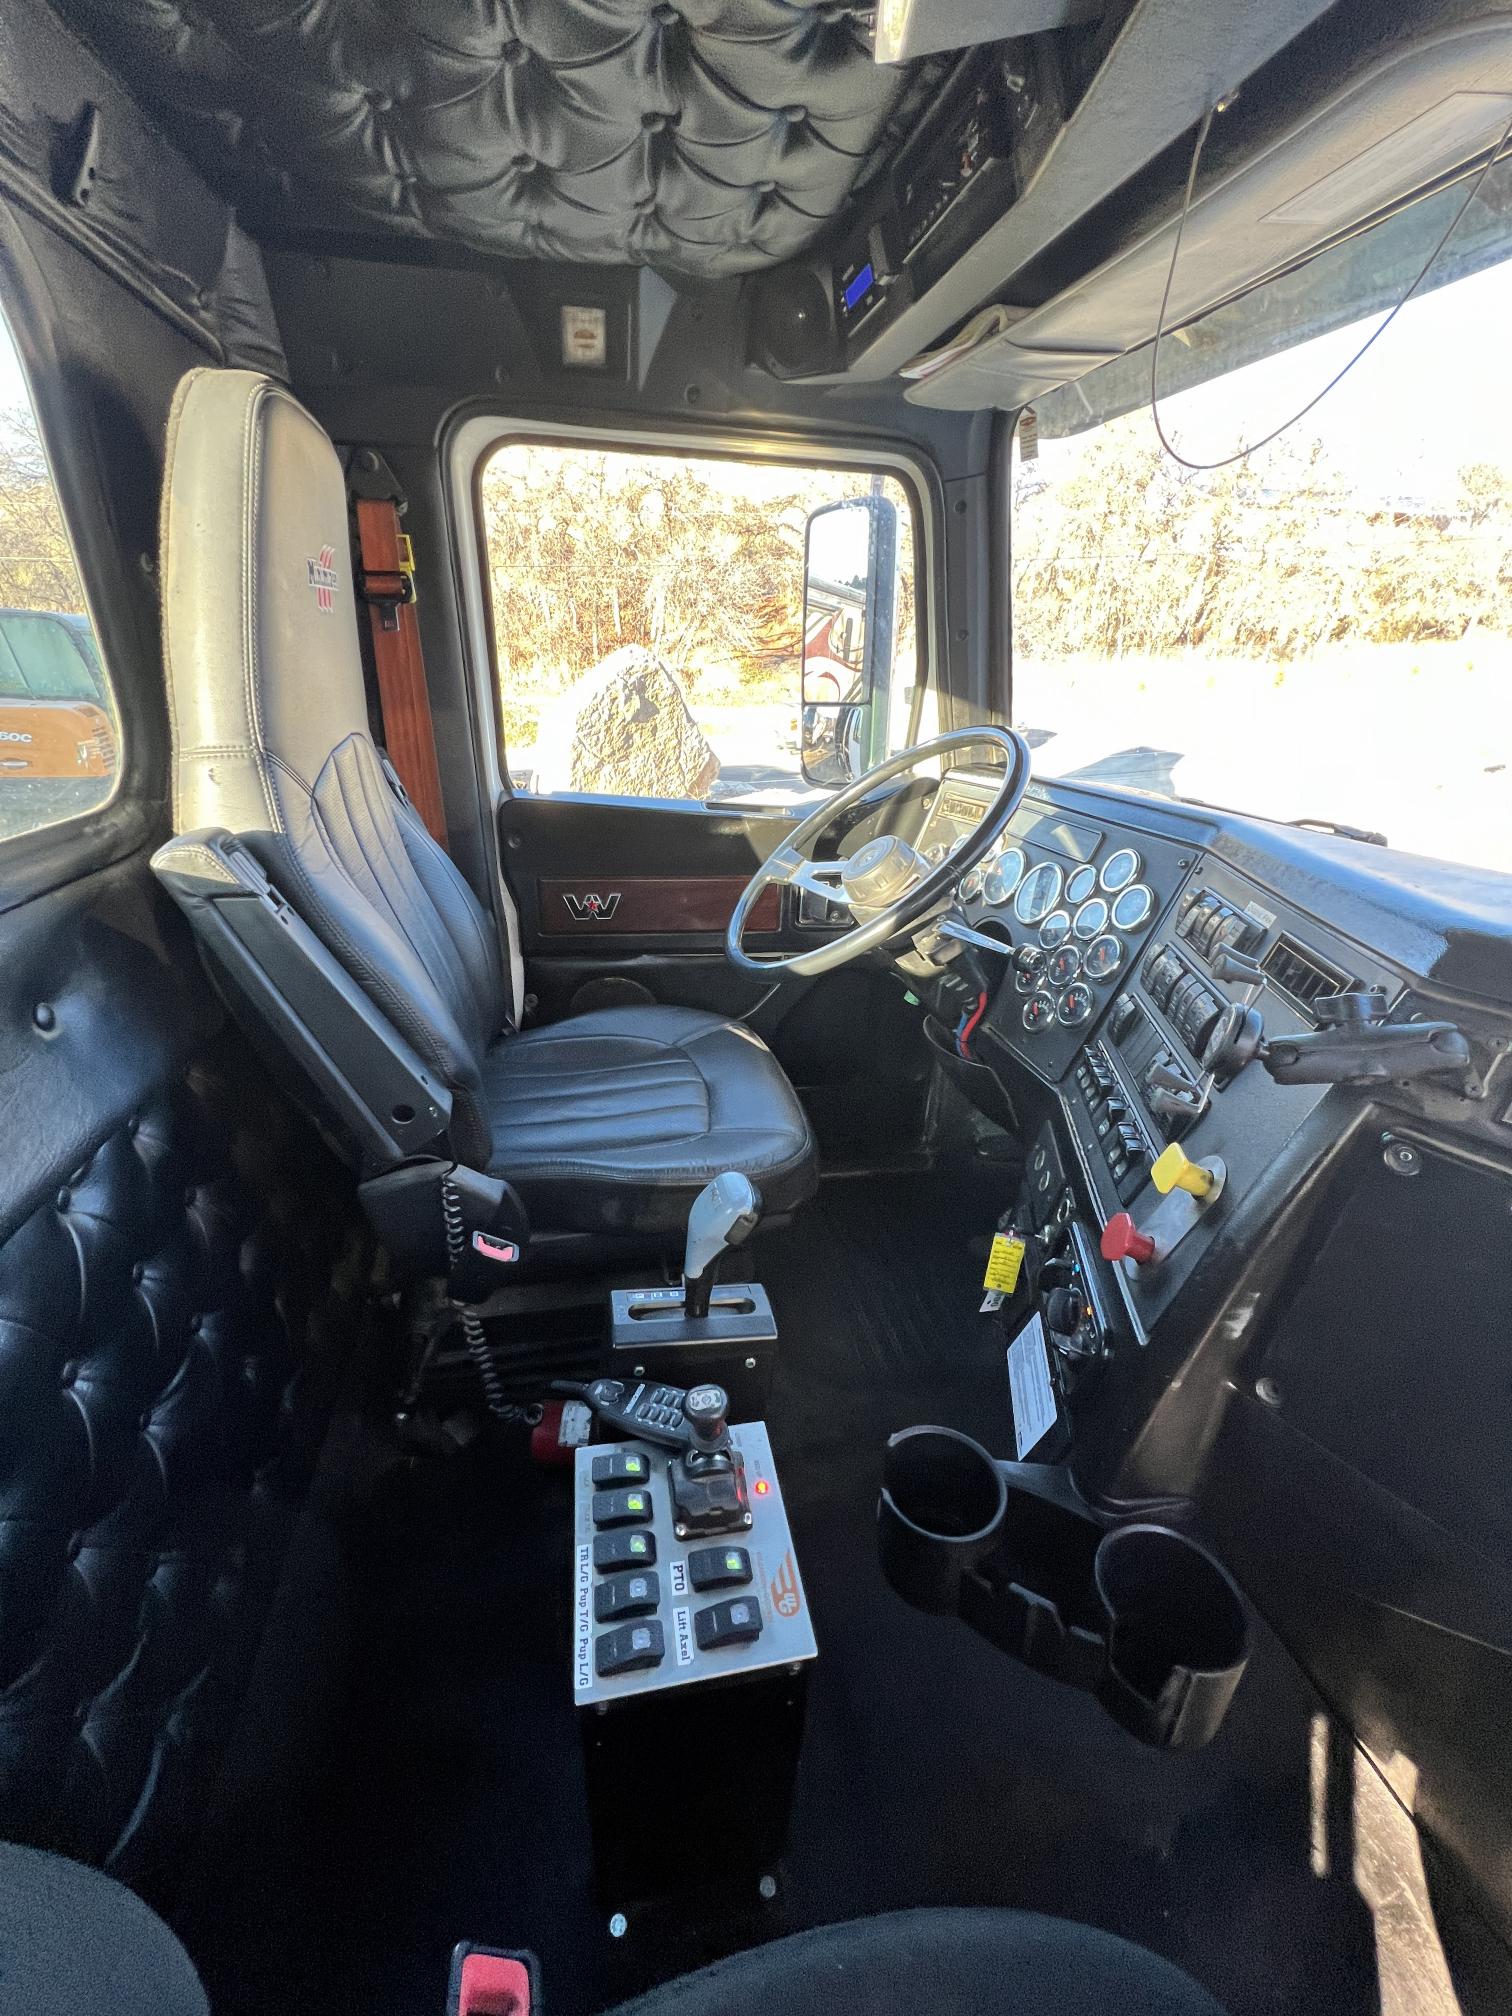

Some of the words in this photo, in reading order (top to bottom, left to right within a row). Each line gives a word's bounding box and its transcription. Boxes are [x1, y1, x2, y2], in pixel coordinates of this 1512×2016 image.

[673, 1564, 685, 1591] PTO
[579, 1587, 589, 1608] Pup
[677, 1611, 687, 1631] Lift
[578, 1637, 589, 1660] Pup
[679, 1634, 690, 1661] Axel
[579, 1662, 589, 1686] L/G
